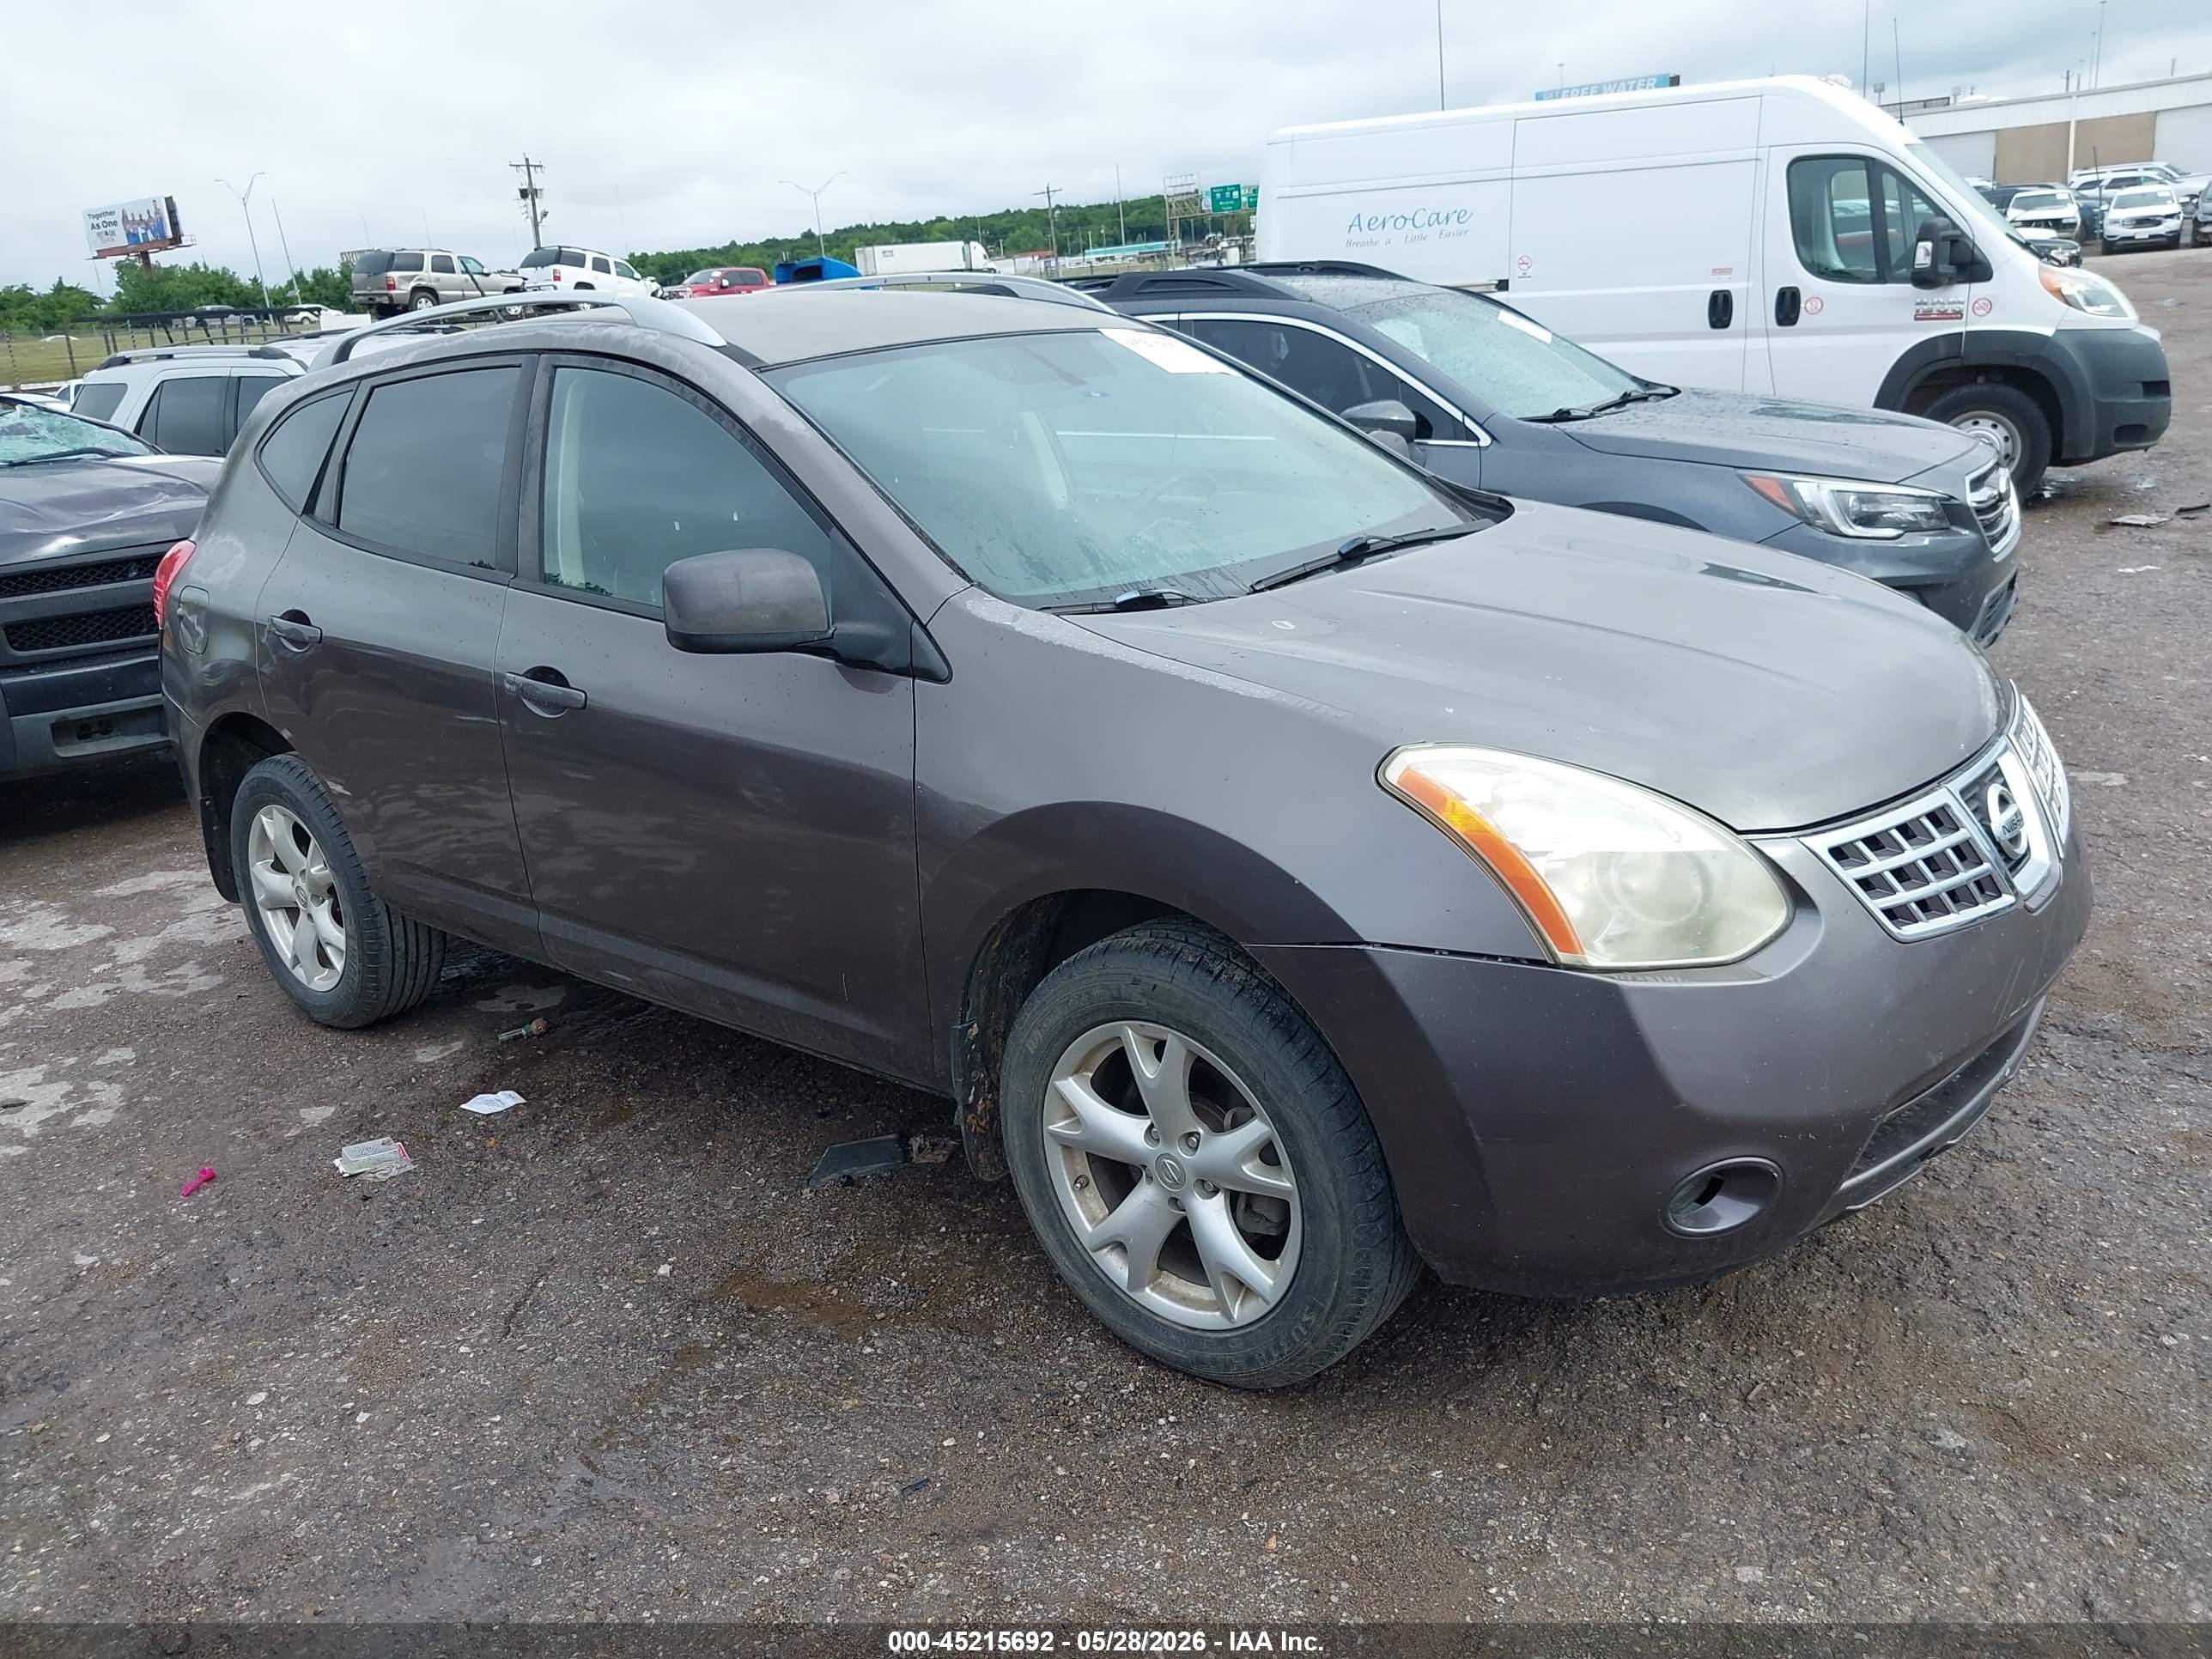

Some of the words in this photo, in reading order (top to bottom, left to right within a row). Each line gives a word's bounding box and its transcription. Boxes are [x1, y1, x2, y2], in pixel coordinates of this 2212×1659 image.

[1560, 85, 1599, 99] FREE
[1603, 78, 1656, 94] WATER
[87, 210, 115, 221] Together
[101, 220, 118, 228] One
[1347, 208, 1474, 234] AeroCare
[1345, 238, 1381, 248] Breathe
[1404, 233, 1429, 244] Little
[1437, 227, 1469, 240] Easier
